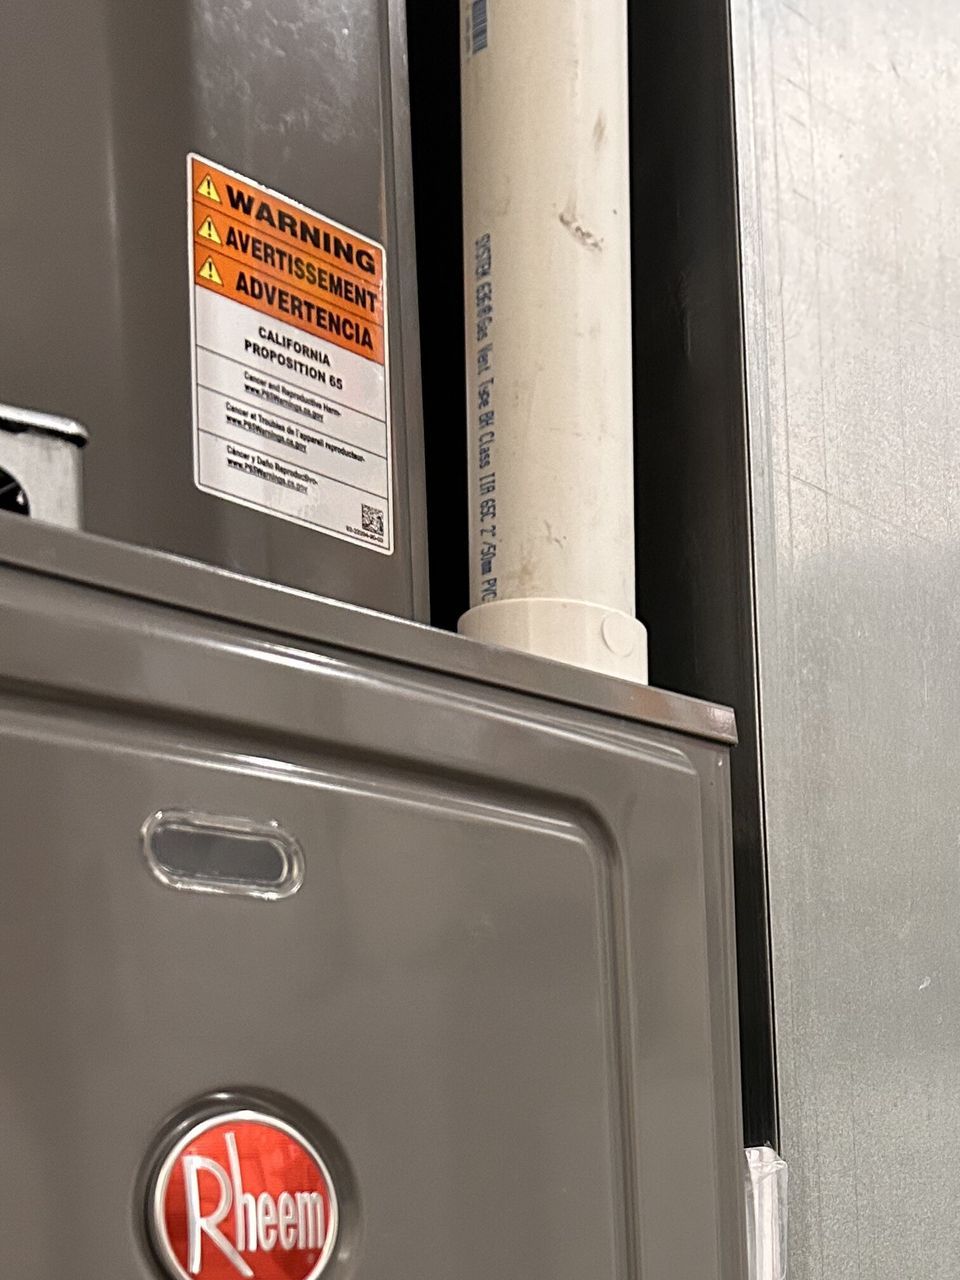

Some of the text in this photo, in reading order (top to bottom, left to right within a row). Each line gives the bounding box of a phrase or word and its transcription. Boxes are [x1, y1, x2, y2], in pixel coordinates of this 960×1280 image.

[226, 184, 376, 274] WARNING
[226, 226, 378, 314] AVERTISSEMENT
[235, 271, 374, 350] ADVERTENCIA
[244, 338, 343, 390] PROPOSITION 65
[259, 326, 331, 367] CALIFORNIA
[478, 342, 494, 376] Vent
[244, 370, 266, 386] Cancer
[268, 382, 280, 393] and
[281, 386, 322, 410] Reproductive
[478, 376, 494, 410] Type
[226, 400, 248, 418] Cancer
[258, 413, 286, 433] Troubles
[286, 425, 295, 436] de
[479, 430, 496, 470] Class
[481, 576, 498, 602] PVC
[182, 1132, 325, 1278] Rheem
